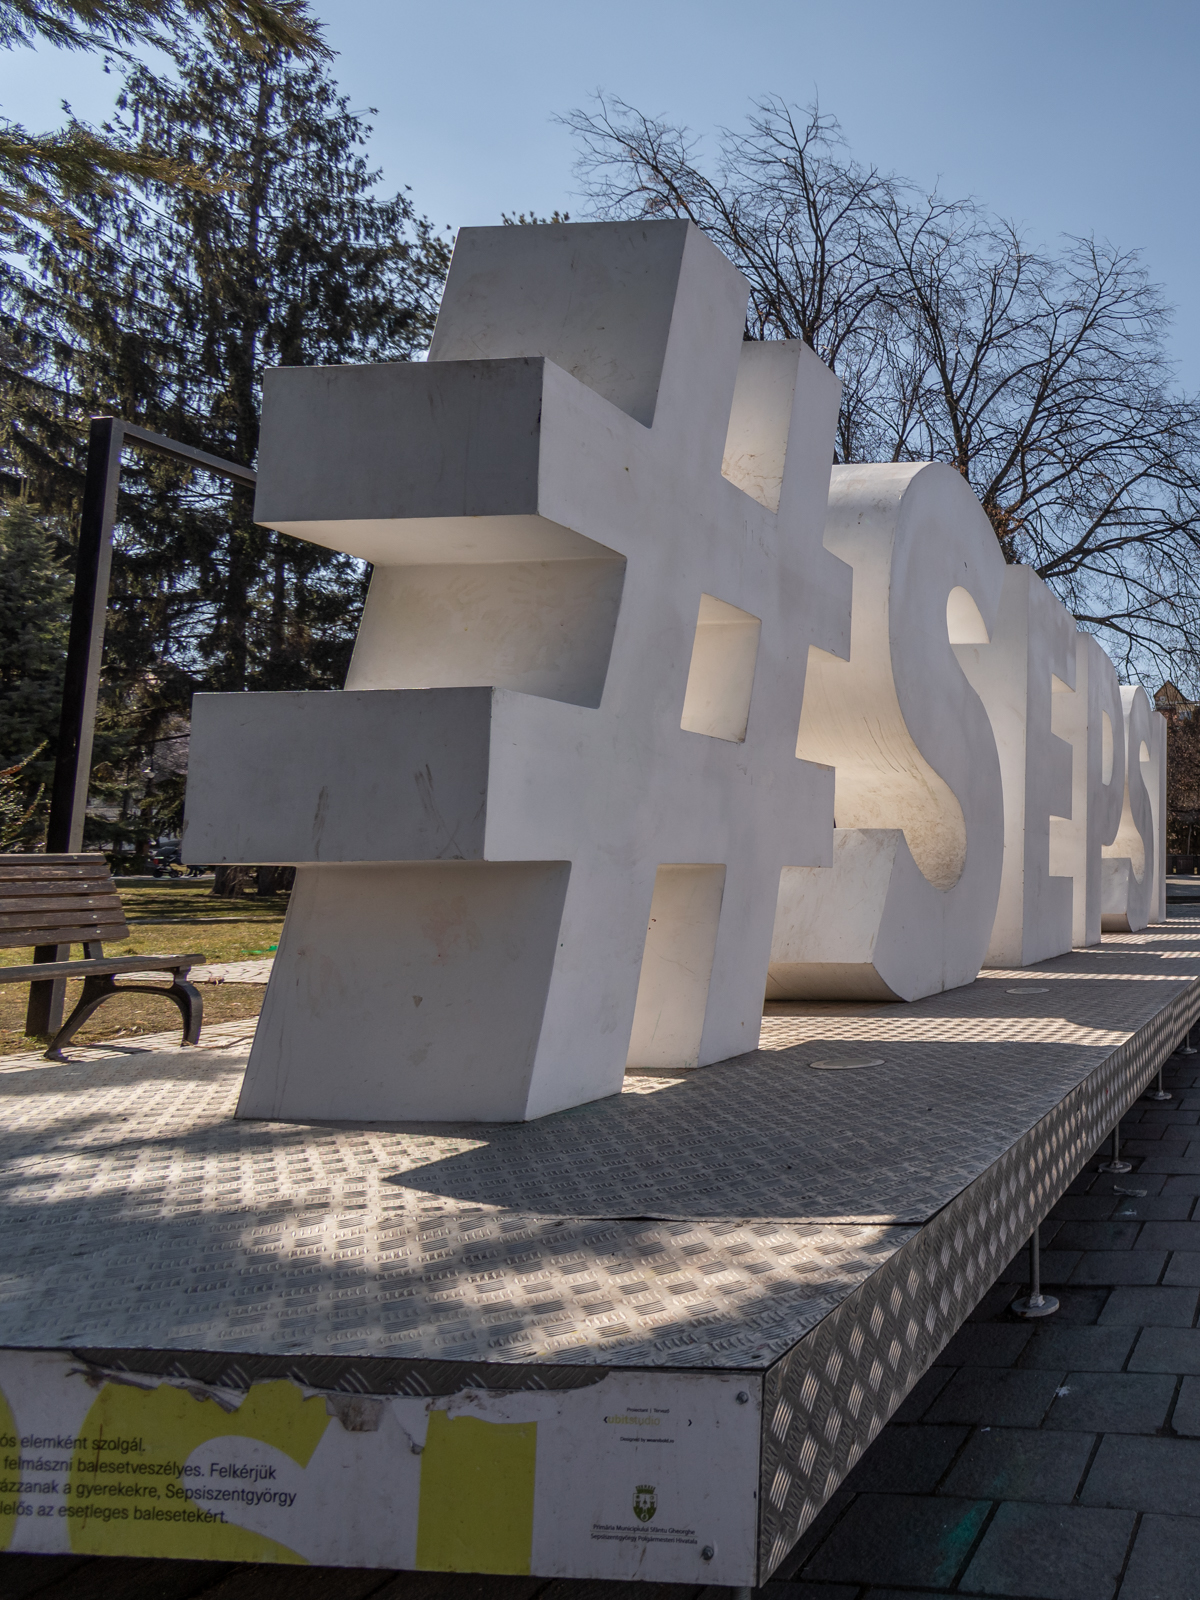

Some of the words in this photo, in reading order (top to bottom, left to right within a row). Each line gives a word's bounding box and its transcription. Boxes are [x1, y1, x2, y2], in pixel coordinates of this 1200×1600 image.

[20, 1433, 87, 1450] elemként
[92, 1436, 146, 1454] szolgál.
[4, 1455, 73, 1471] felmászni
[77, 1457, 205, 1479] balesetveszélyes.
[210, 1462, 277, 1482] Felkérjük
[0, 1478, 59, 1494] ázzanak
[63, 1483, 72, 1494] a
[76, 1482, 161, 1500] gyerekekre,
[165, 1483, 297, 1507] Sepsiszentgyörgy
[37, 1504, 54, 1517] az
[58, 1504, 129, 1522] esetleges
[133, 1506, 229, 1524] balesetekért.
[668, 1527, 695, 1536] Gheorghe
[675, 1537, 698, 1545] Hivatala
